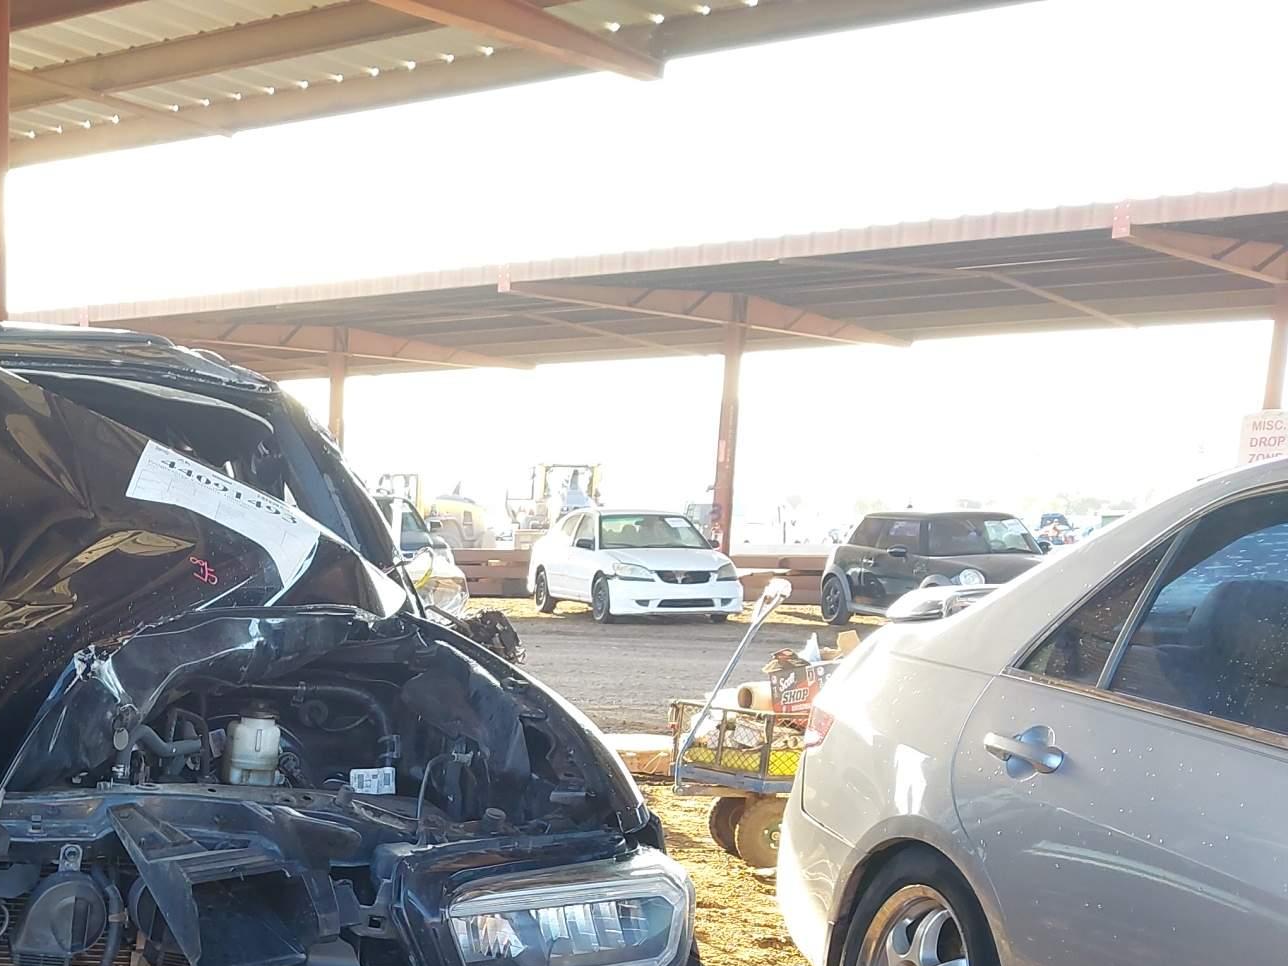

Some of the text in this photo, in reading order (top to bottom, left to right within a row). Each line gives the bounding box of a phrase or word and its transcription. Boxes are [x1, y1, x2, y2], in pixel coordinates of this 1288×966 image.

[1252, 420, 1287, 431] MISC.
[1249, 436, 1286, 448] DROP
[160, 459, 298, 525] 44091493
[782, 687, 810, 705] SHOP
